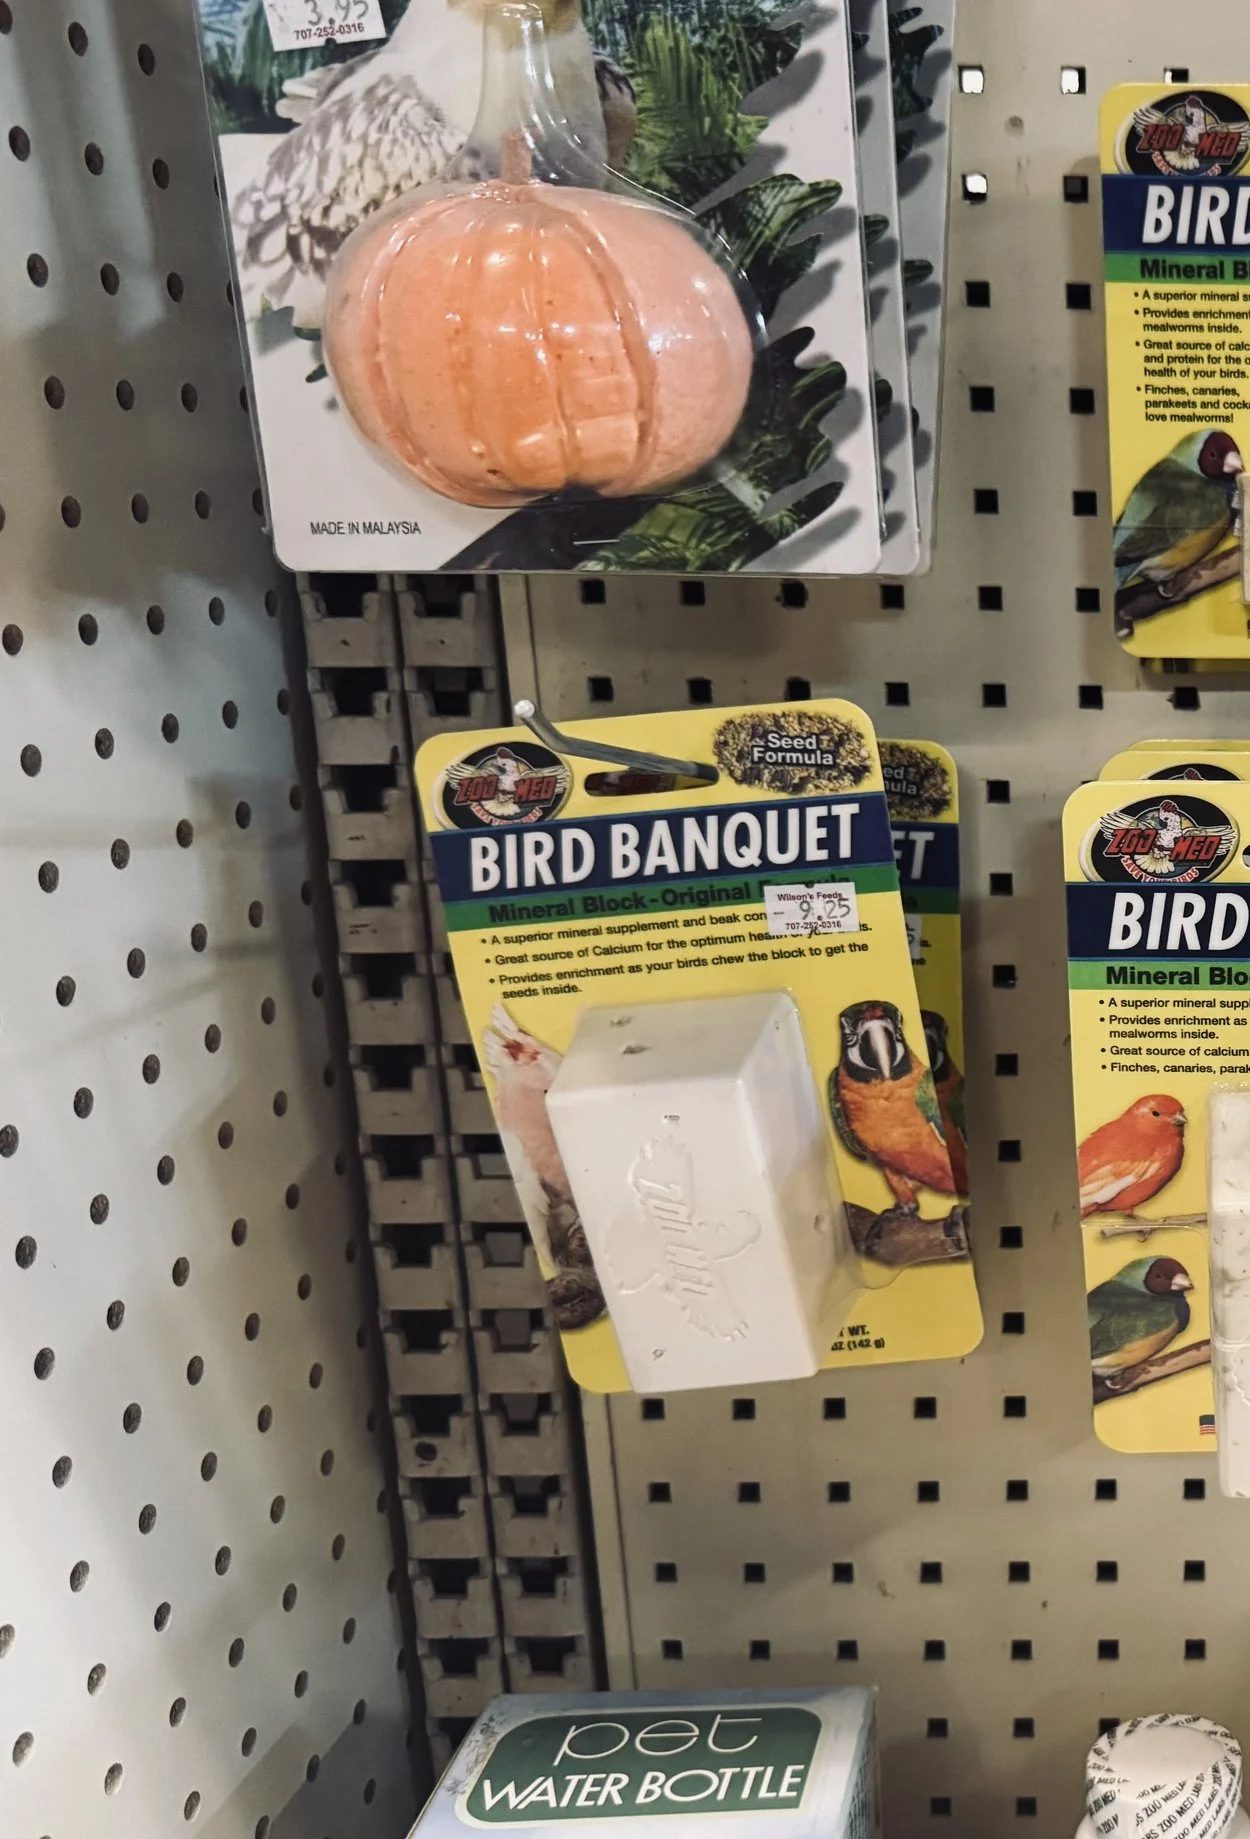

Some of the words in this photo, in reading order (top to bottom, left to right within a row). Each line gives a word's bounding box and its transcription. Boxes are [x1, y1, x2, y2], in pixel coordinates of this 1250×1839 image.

[293, 23, 365, 40] 707-252-0316
[1140, 258, 1225, 279] Mineral
[1145, 384, 1189, 396] Finches,
[1192, 386, 1240, 398] canaries,
[1145, 399, 1197, 410] parakeets
[1200, 399, 1220, 409] and
[1145, 412, 1167, 422] love
[1170, 413, 1234, 423] mealworms!
[310, 521, 345, 535] MADE
[348, 521, 360, 535] IN
[363, 521, 422, 535] MALAYSIA
[767, 733, 818, 750] Seed
[753, 748, 835, 766] Formula
[470, 828, 596, 892] BIRD
[611, 803, 860, 879] BANQUET
[1105, 828, 1157, 855] ZOO
[1170, 835, 1221, 862] MED
[777, 892, 815, 902] Wilson's
[817, 890, 843, 901] Feeds
[488, 898, 574, 923] Mineral
[799, 897, 851, 922] 9.25
[1108, 892, 1250, 950] BIRD
[1106, 966, 1200, 986] Mineral
[502, 985, 540, 1000] seeds
[542, 983, 582, 996] inside.
[1108, 998, 1118, 1008] A
[1121, 998, 1169, 1010] superior
[1173, 998, 1216, 1008] mineral
[1110, 1015, 1161, 1026] Provides
[1164, 1016, 1230, 1026] enrichment
[1234, 1018, 1248, 1026] as
[1110, 1029, 1178, 1040] mealworms
[1180, 1029, 1220, 1040] inside.
[1110, 1063, 1160, 1074] Finches,
[1163, 1064, 1216, 1074] canaries,
[551, 1713, 763, 1767] pet
[482, 1772, 630, 1811] WATER
[635, 1764, 805, 1804] BOTTLE
